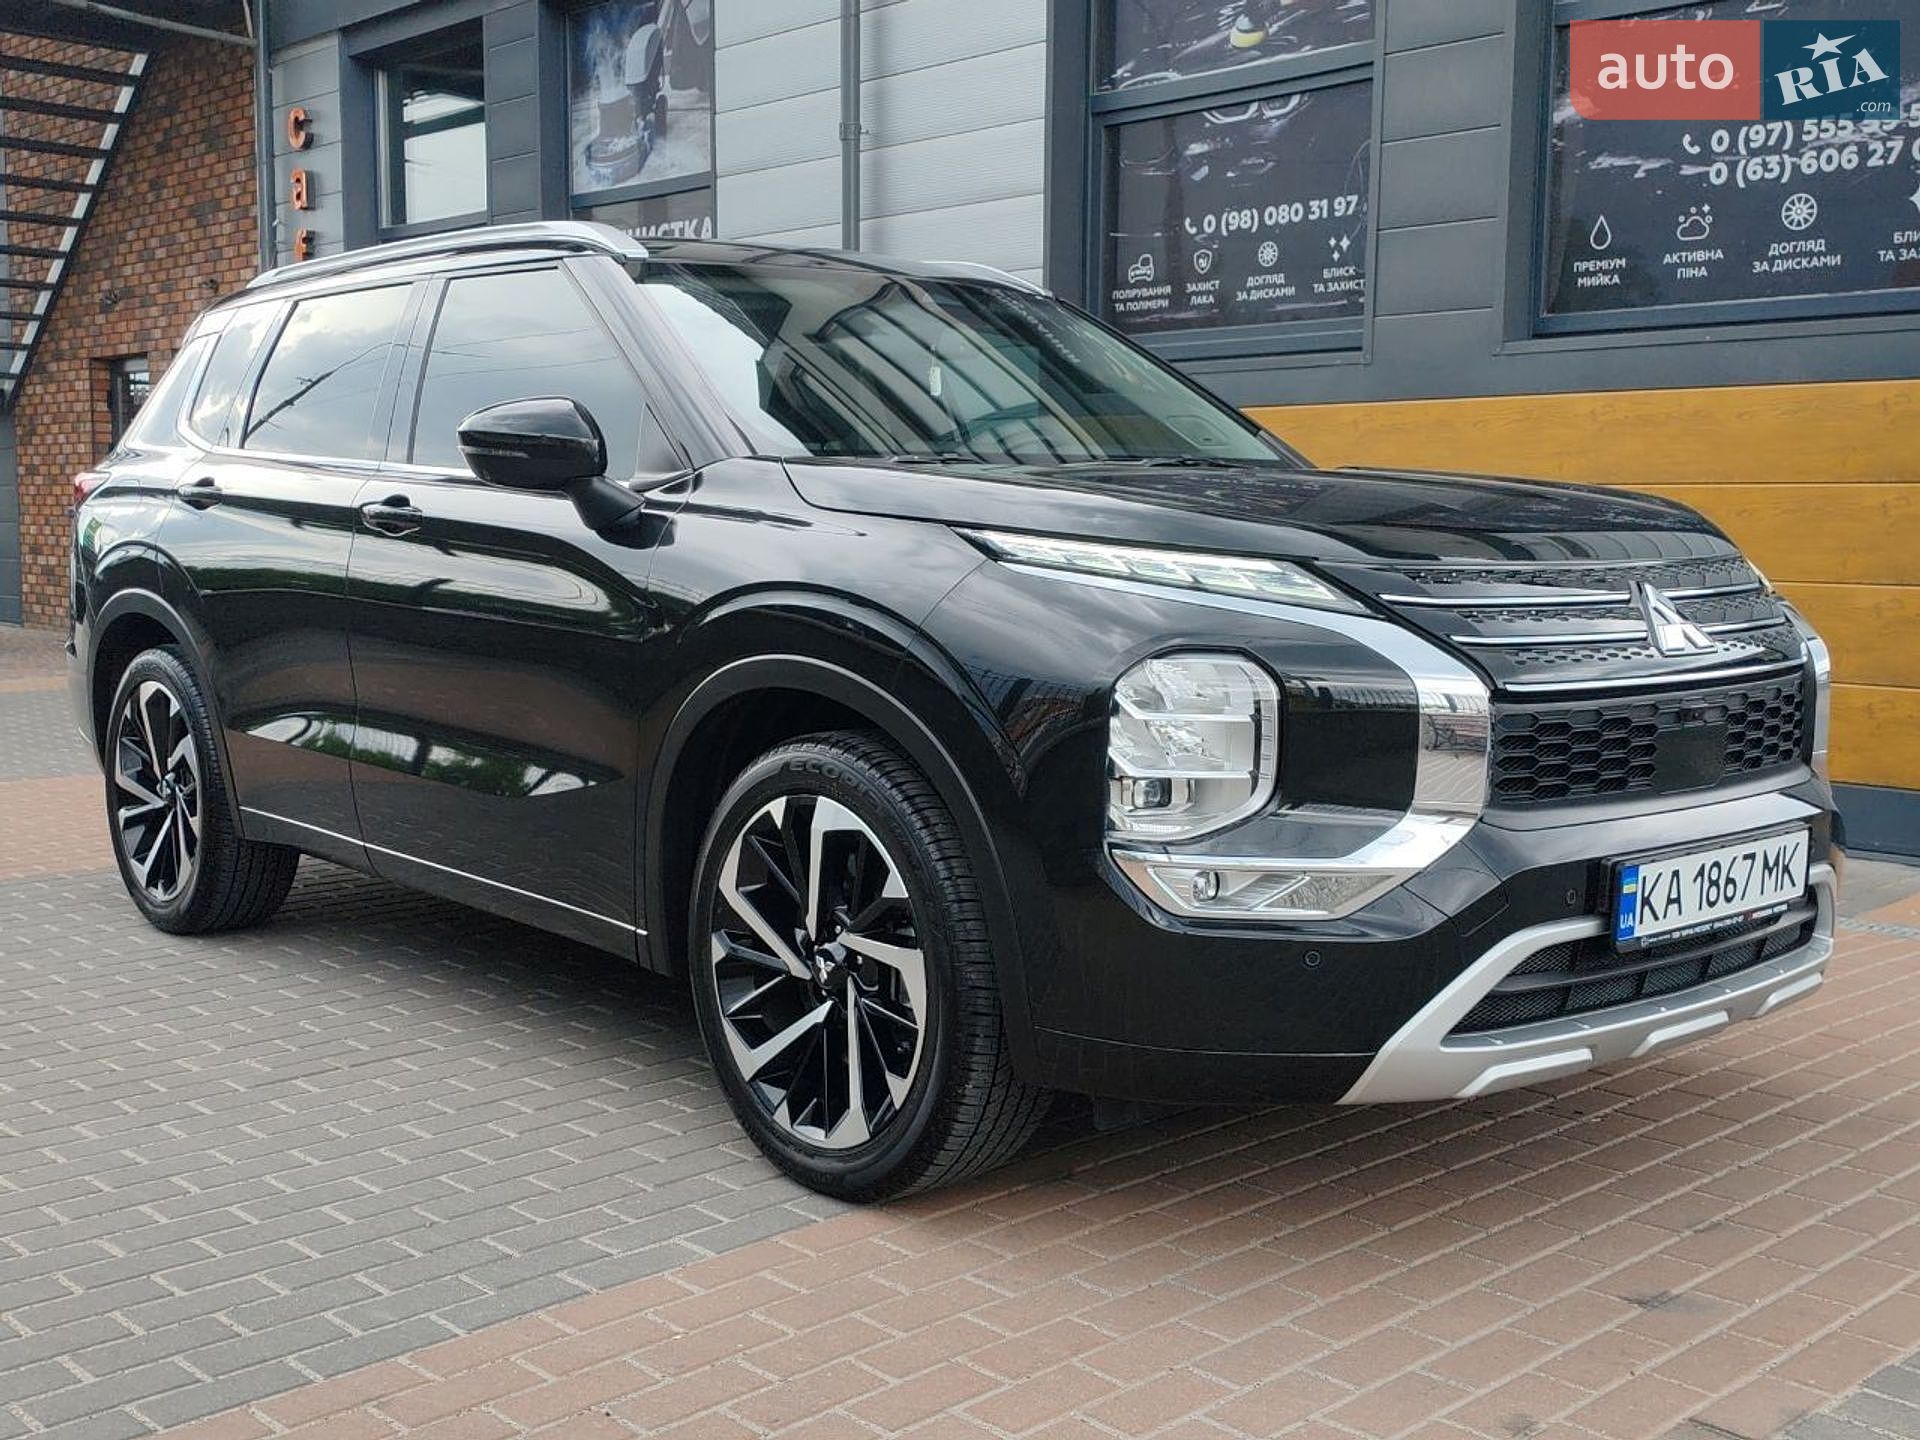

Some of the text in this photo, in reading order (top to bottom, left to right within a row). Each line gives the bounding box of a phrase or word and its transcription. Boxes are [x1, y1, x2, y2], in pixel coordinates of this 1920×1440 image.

[1711, 129, 1730, 152] 0
[1738, 121, 1794, 155] (97)
[1709, 162, 1728, 185] 0
[1736, 154, 1792, 188] (63)
[1800, 146, 1859, 174] 606
[1867, 140, 1904, 167] 27
[1203, 195, 1358, 236] 0 (98) 080 31 97
[1768, 239, 1826, 257] ДОГЛЯД
[1878, 250, 1895, 262] ТА
[1573, 258, 1626, 272] ПРЕМІУМ
[1663, 249, 1724, 265] АКТИВНА
[1752, 254, 1841, 273] ЗА ДИСКАМИ
[1247, 273, 1285, 287] ДОГЛЯД
[1577, 273, 1620, 287] МИЙКА
[1677, 267, 1708, 279] ПІНА
[1639, 842, 1800, 925] KA 1867 MK
[1620, 914, 1633, 929] UA
